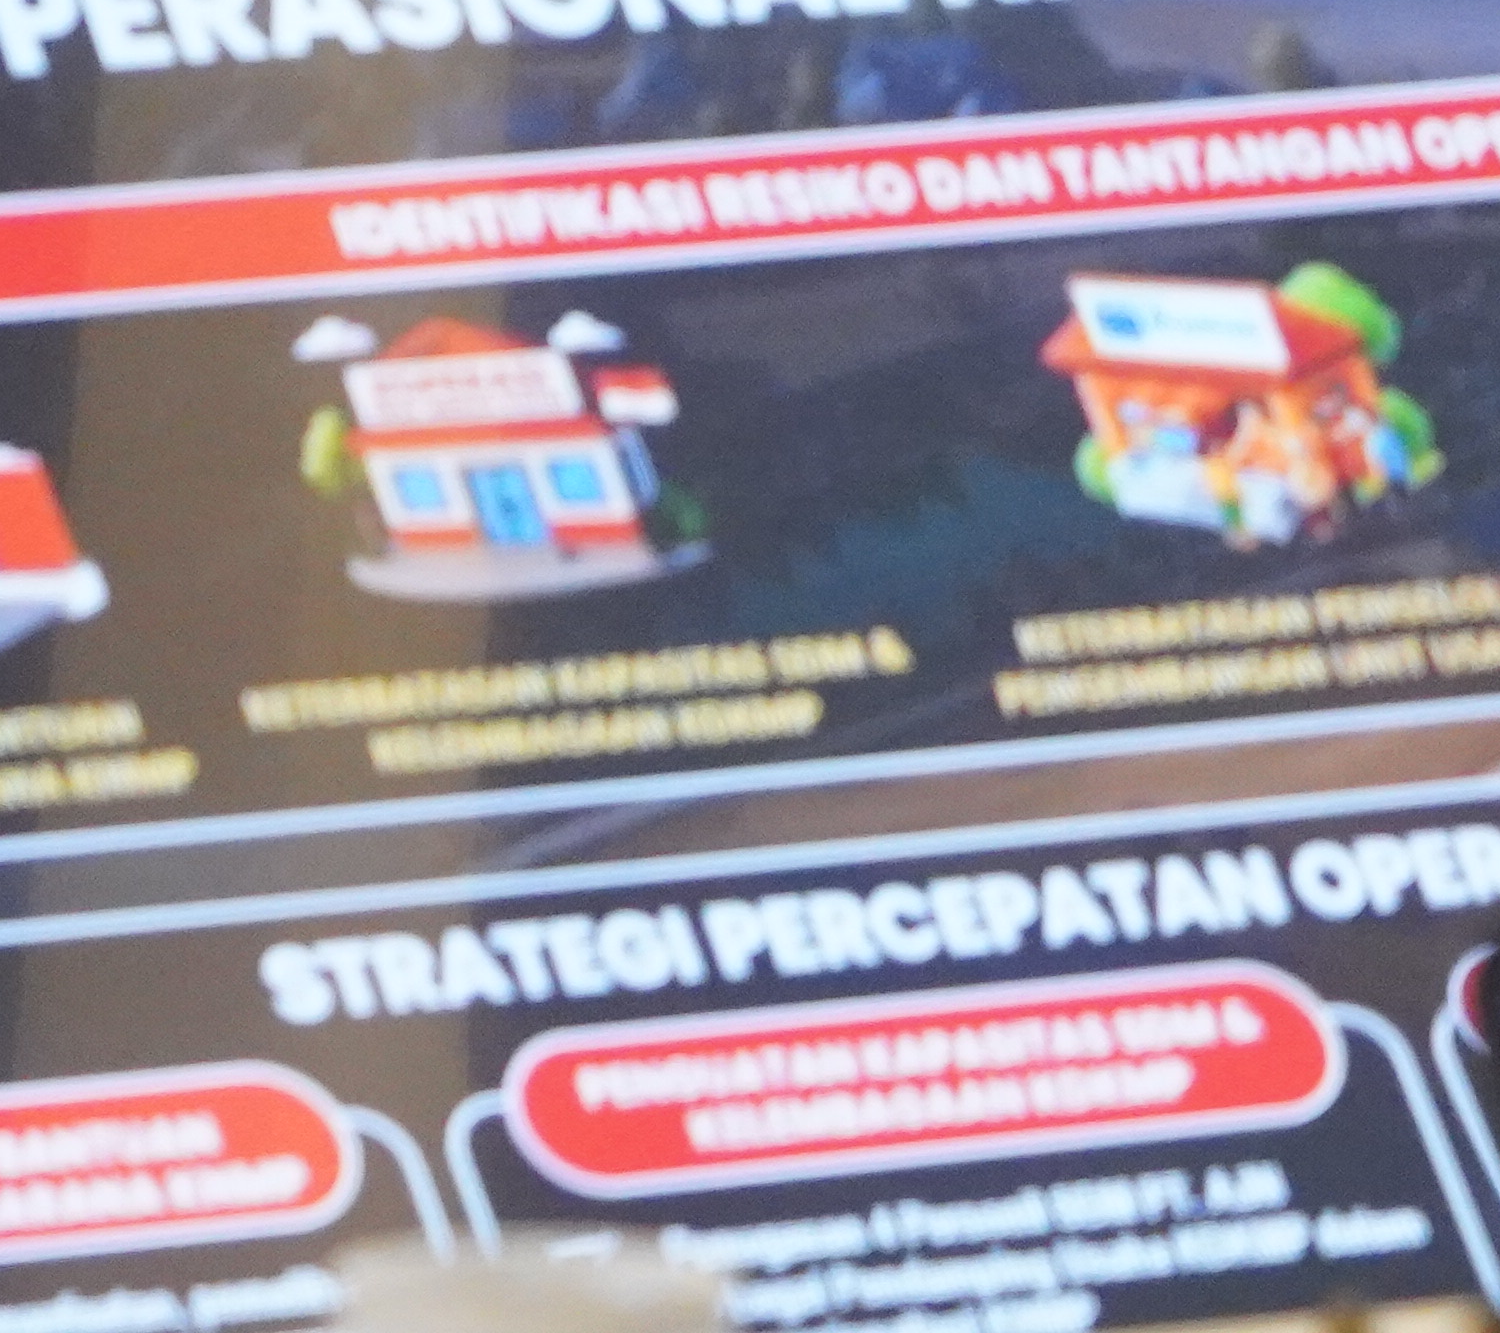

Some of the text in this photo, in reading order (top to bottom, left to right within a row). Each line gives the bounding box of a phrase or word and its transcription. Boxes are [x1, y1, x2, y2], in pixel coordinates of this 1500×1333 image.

[332, 174, 705, 262] IDENTIFIKASI
[711, 160, 914, 228] RESIKO
[919, 150, 1046, 211] DAN
[1048, 118, 1414, 201] TANTANGAN
[258, 906, 704, 1026] STRATEGI
[701, 846, 1290, 985] PERCEPATAN
